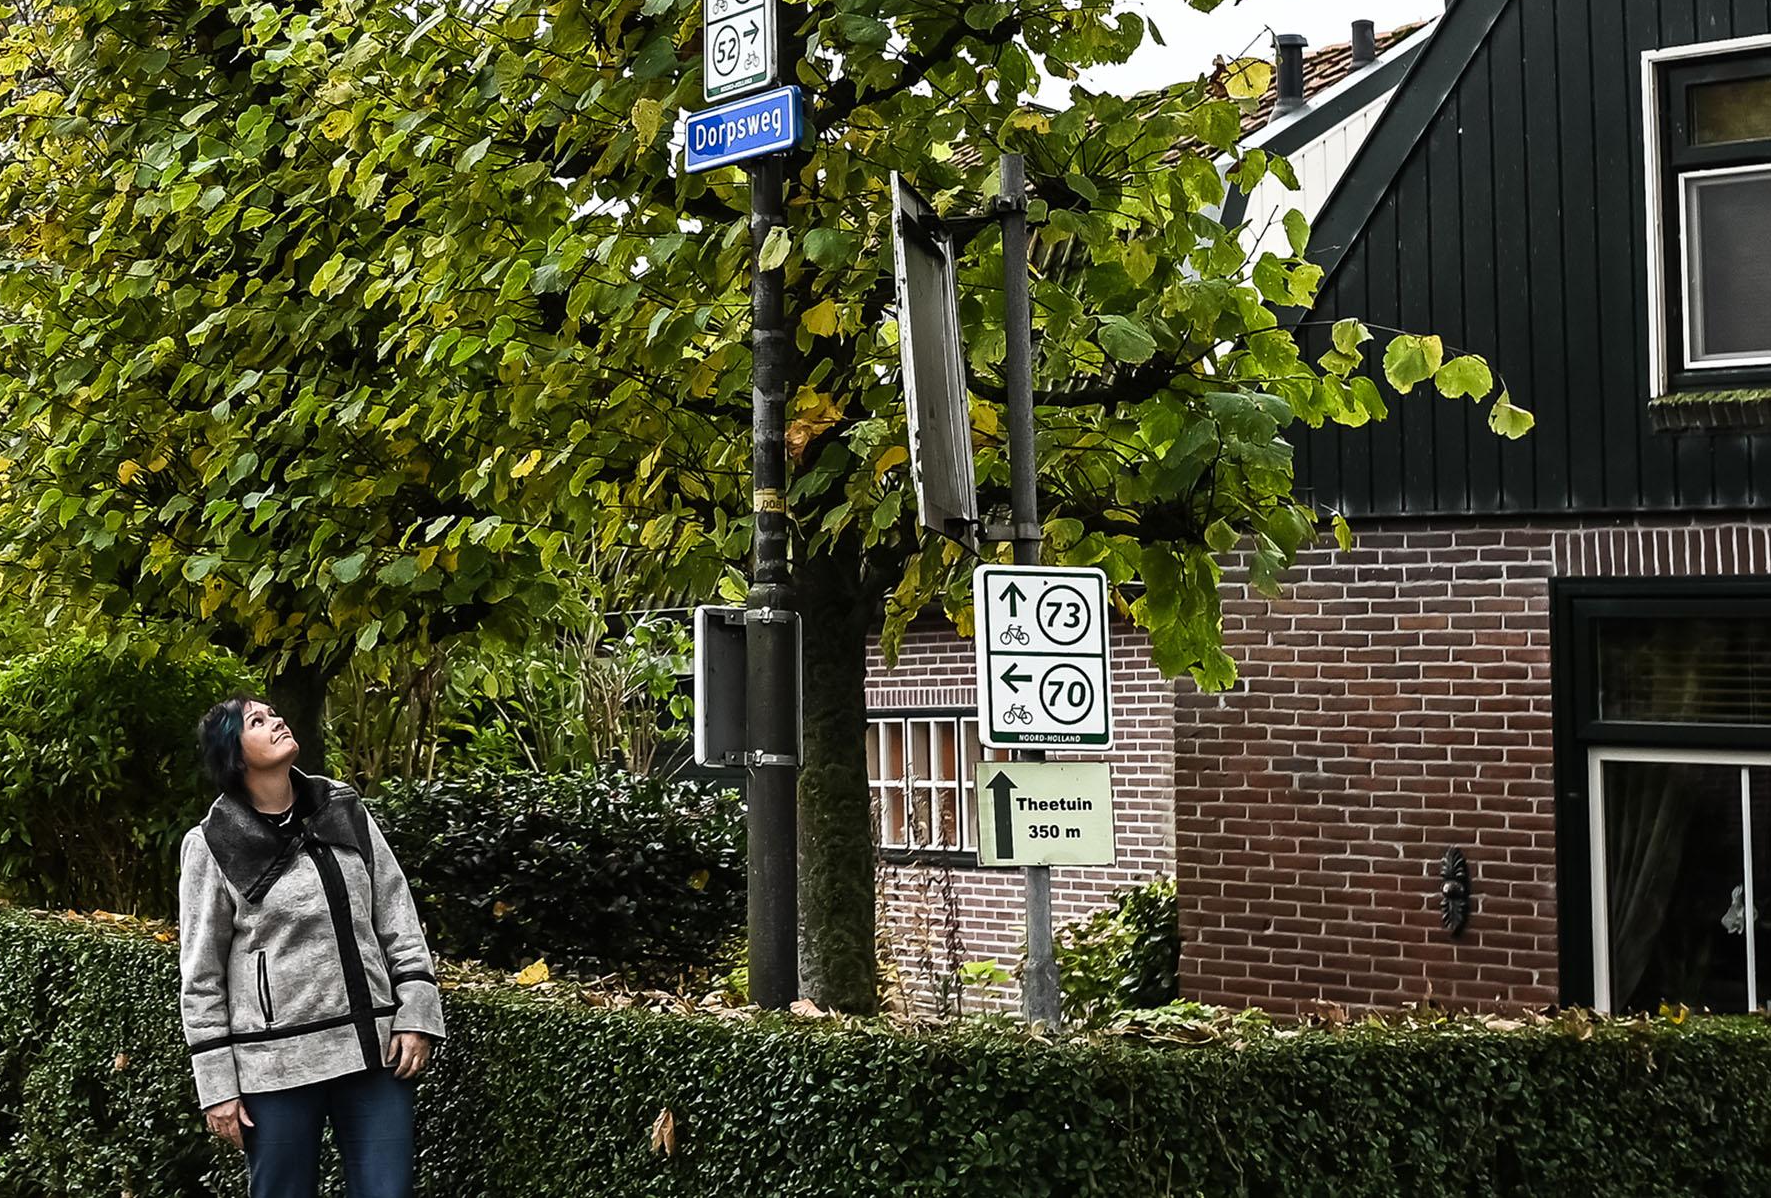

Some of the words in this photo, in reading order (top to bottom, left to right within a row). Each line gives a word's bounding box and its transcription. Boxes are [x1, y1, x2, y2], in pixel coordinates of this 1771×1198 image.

[717, 38, 737, 64] 52
[695, 107, 782, 151] Dorpsweg
[1046, 602, 1081, 629] 73
[1047, 681, 1086, 708] 70
[1018, 734, 1081, 743] NOORD-HOLLAND
[1016, 797, 1092, 811] Theetuin
[1028, 825, 1060, 839] 350
[1065, 828, 1080, 839] m
